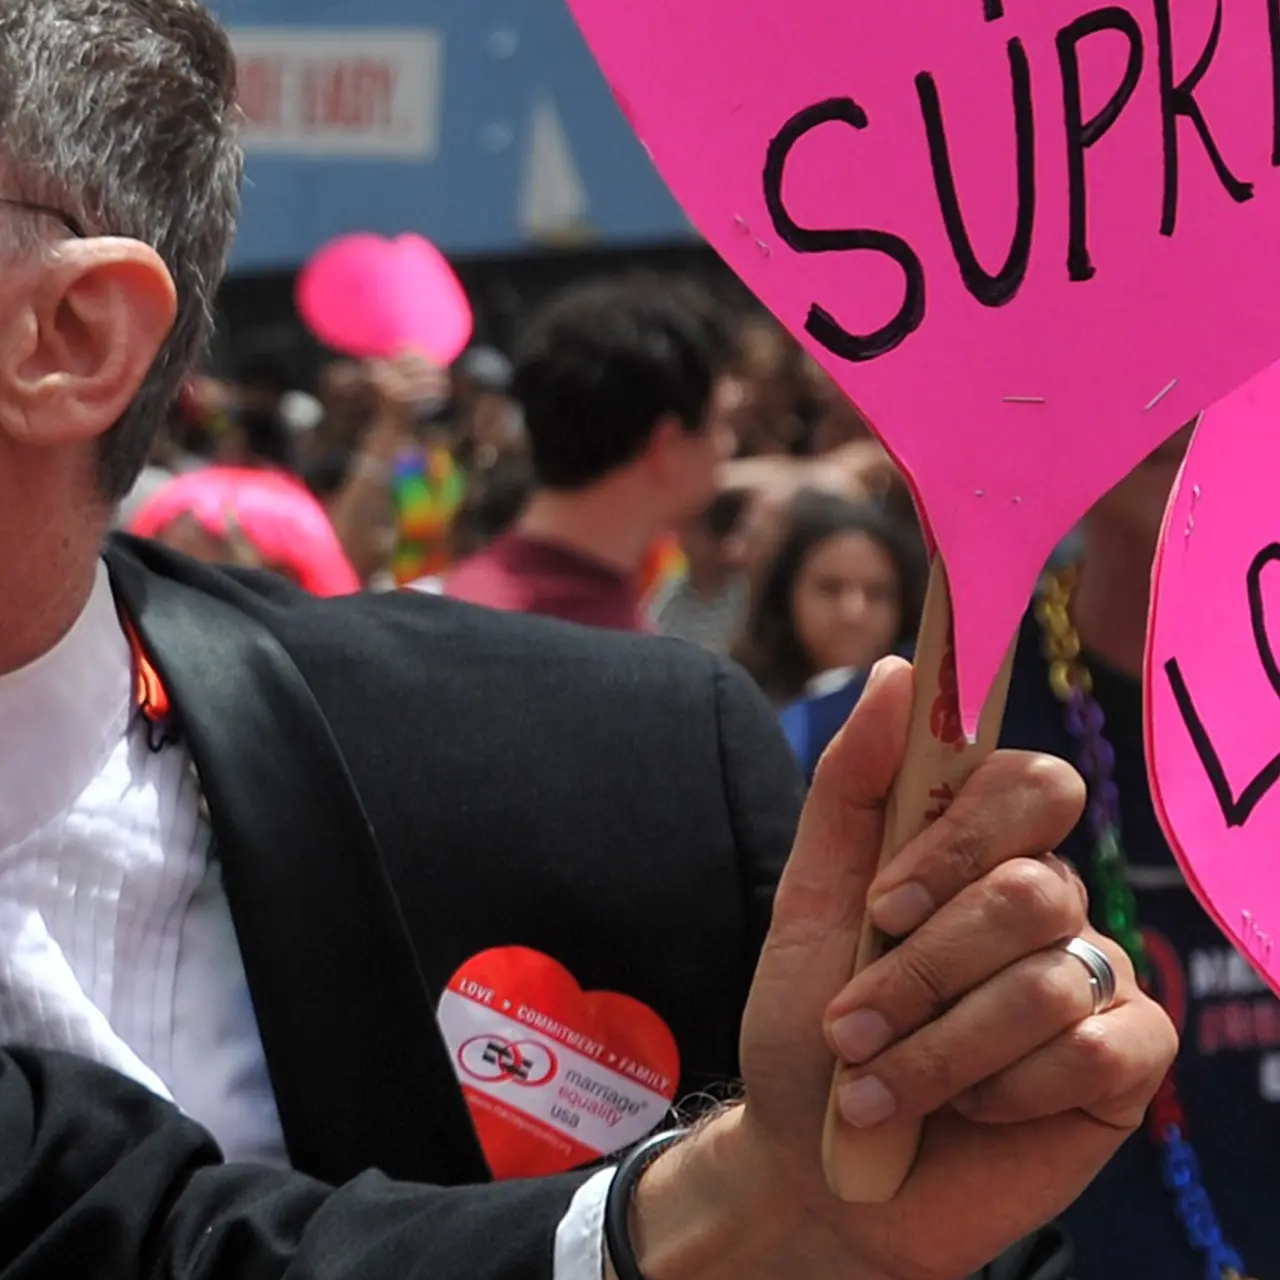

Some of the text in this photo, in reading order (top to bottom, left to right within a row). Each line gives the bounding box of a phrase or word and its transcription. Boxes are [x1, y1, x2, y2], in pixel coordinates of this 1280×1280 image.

[459, 977, 671, 1092] LOVE COMMITMENT FAMILY
[550, 1103, 582, 1129] usa
[558, 1086, 624, 1128] equality
